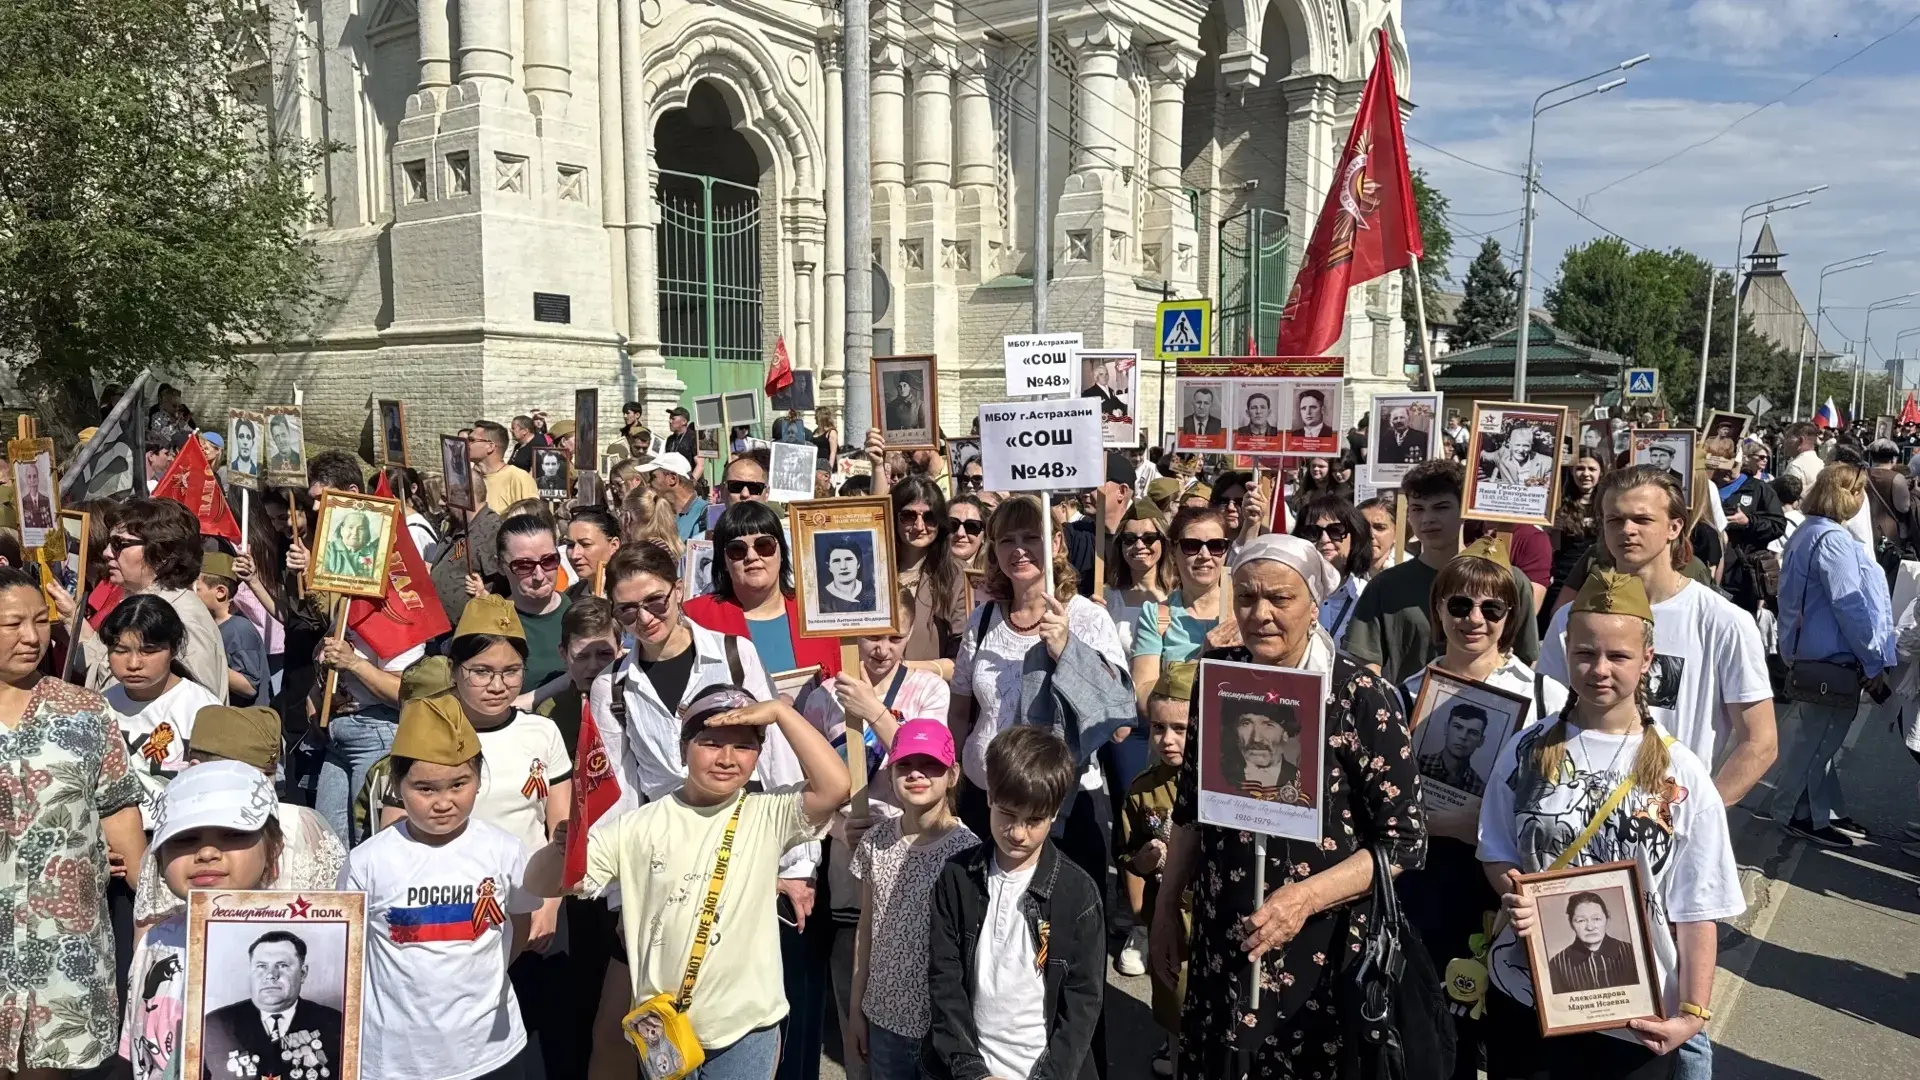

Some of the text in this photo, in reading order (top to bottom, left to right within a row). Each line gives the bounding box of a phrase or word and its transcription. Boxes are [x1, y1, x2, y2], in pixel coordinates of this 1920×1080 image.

[1007, 338, 1079, 348] МБОУ г.Астрахани
[1022, 352, 1067, 366] «СОШ
[1026, 374, 1070, 388] №48»
[985, 409, 1093, 422] МБОУ г.Астрахани
[1005, 428, 1073, 448] «СОШ
[1010, 461, 1078, 480] №48»
[407, 885, 473, 906] РОССИЯ
[212, 894, 343, 921] бессмертный ПОЛК
[1569, 989, 1626, 1003] Александрова
[1568, 1002, 1595, 1013] Мария
[1596, 997, 1630, 1008] Исаевна
